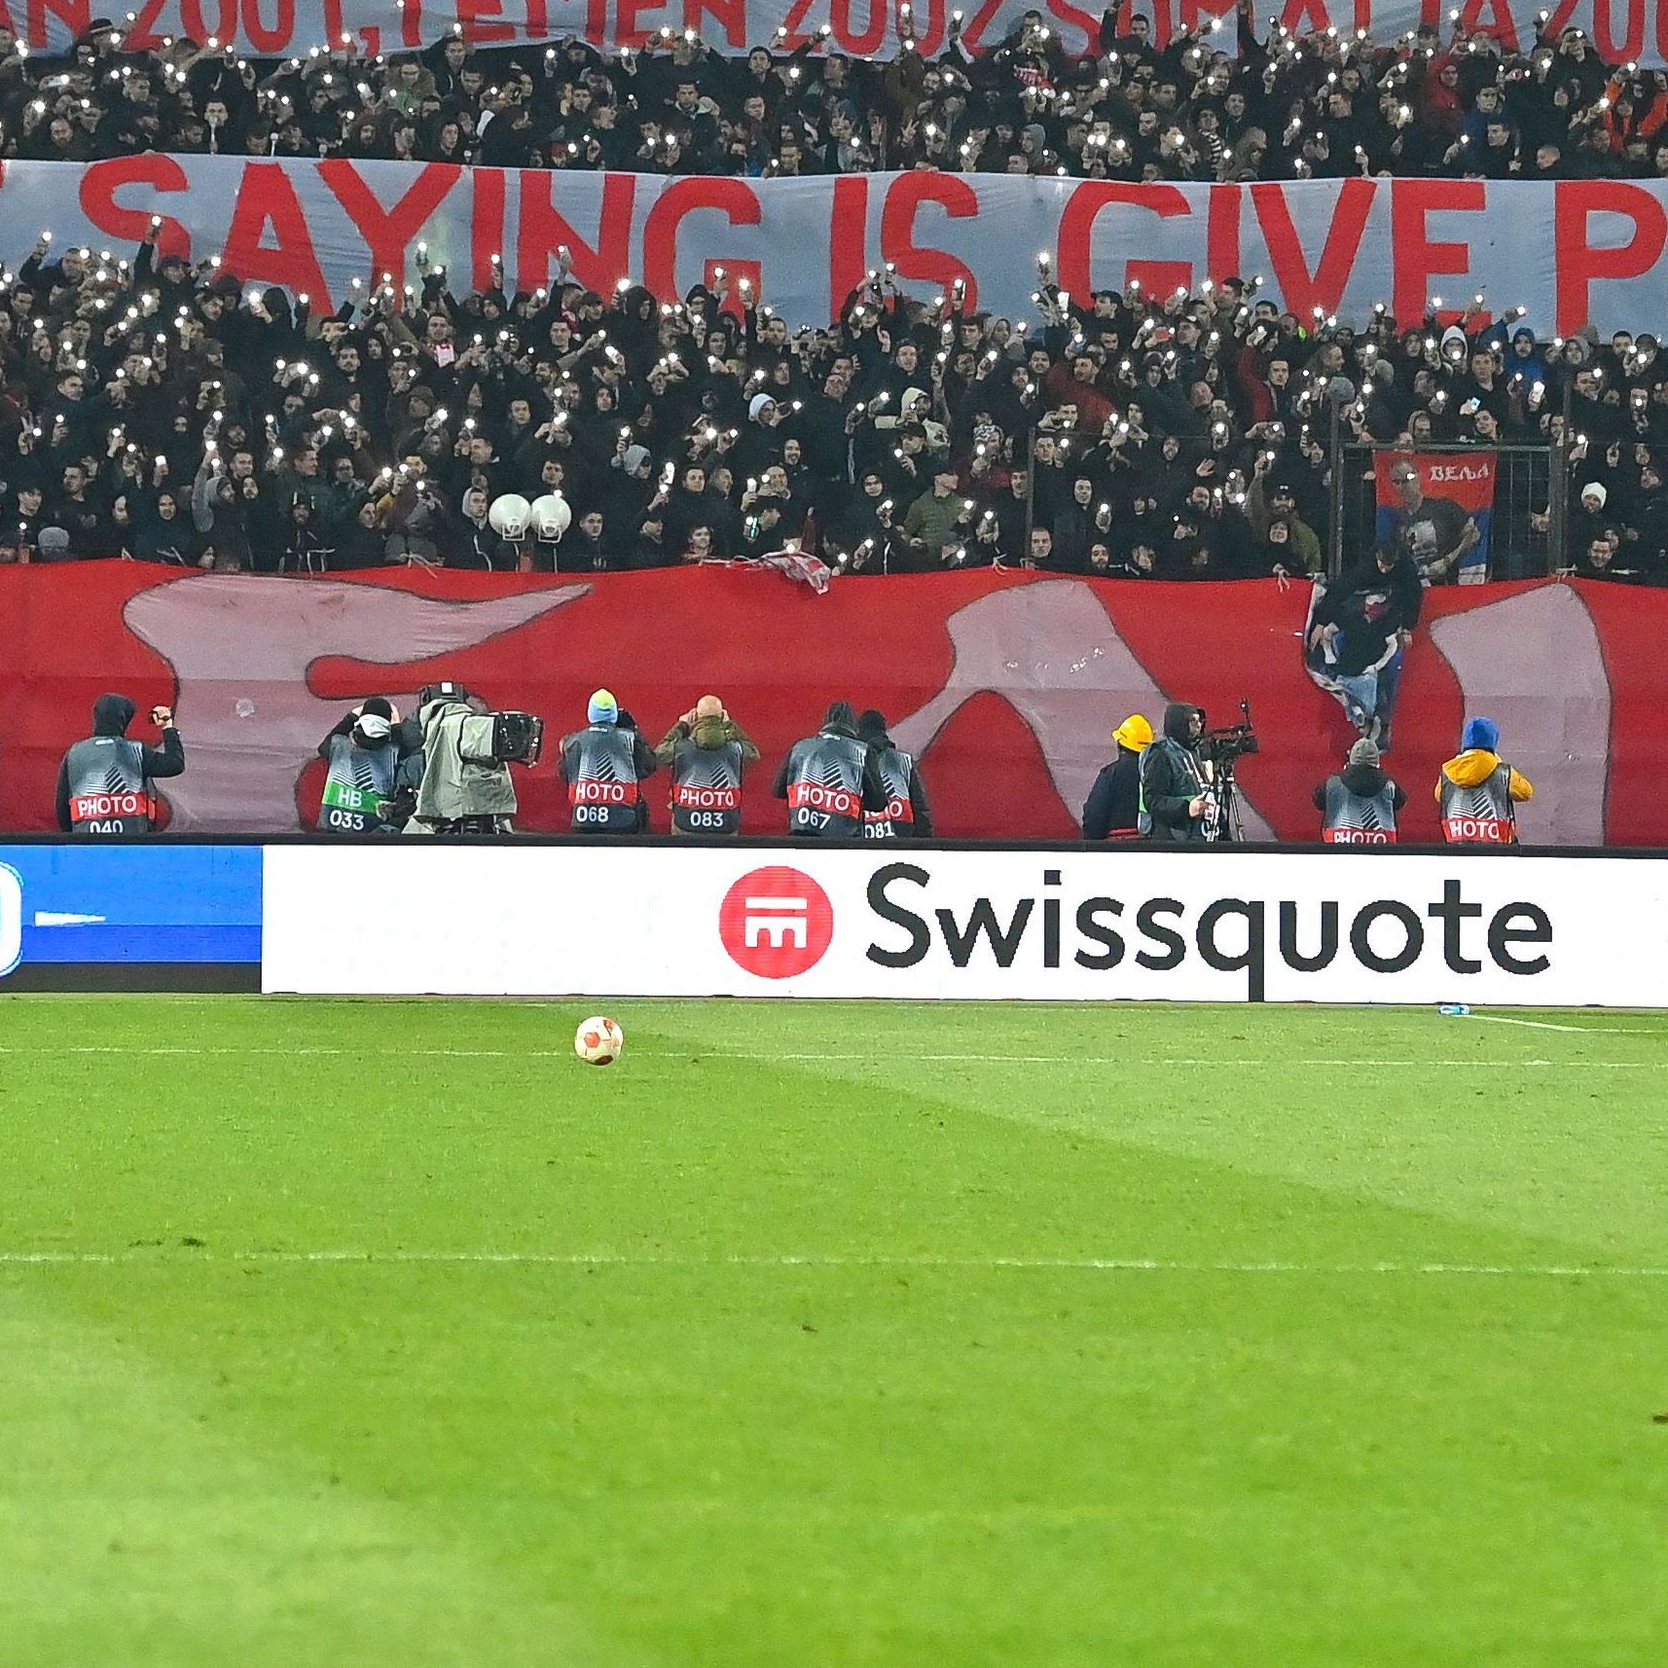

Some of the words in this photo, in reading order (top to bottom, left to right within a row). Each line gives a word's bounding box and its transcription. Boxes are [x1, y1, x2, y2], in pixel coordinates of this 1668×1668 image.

[79, 152, 762, 320] SAYING
[830, 169, 979, 326] IS
[1057, 177, 1494, 332] GIVE
[78, 795, 137, 816] PHOTO
[338, 787, 362, 807] HB
[679, 790, 734, 807] PHOTO
[329, 809, 364, 831] 033
[576, 806, 609, 823] 068
[690, 811, 724, 827] 083
[797, 806, 831, 830] 067
[865, 863, 1554, 1002] Swissquote
